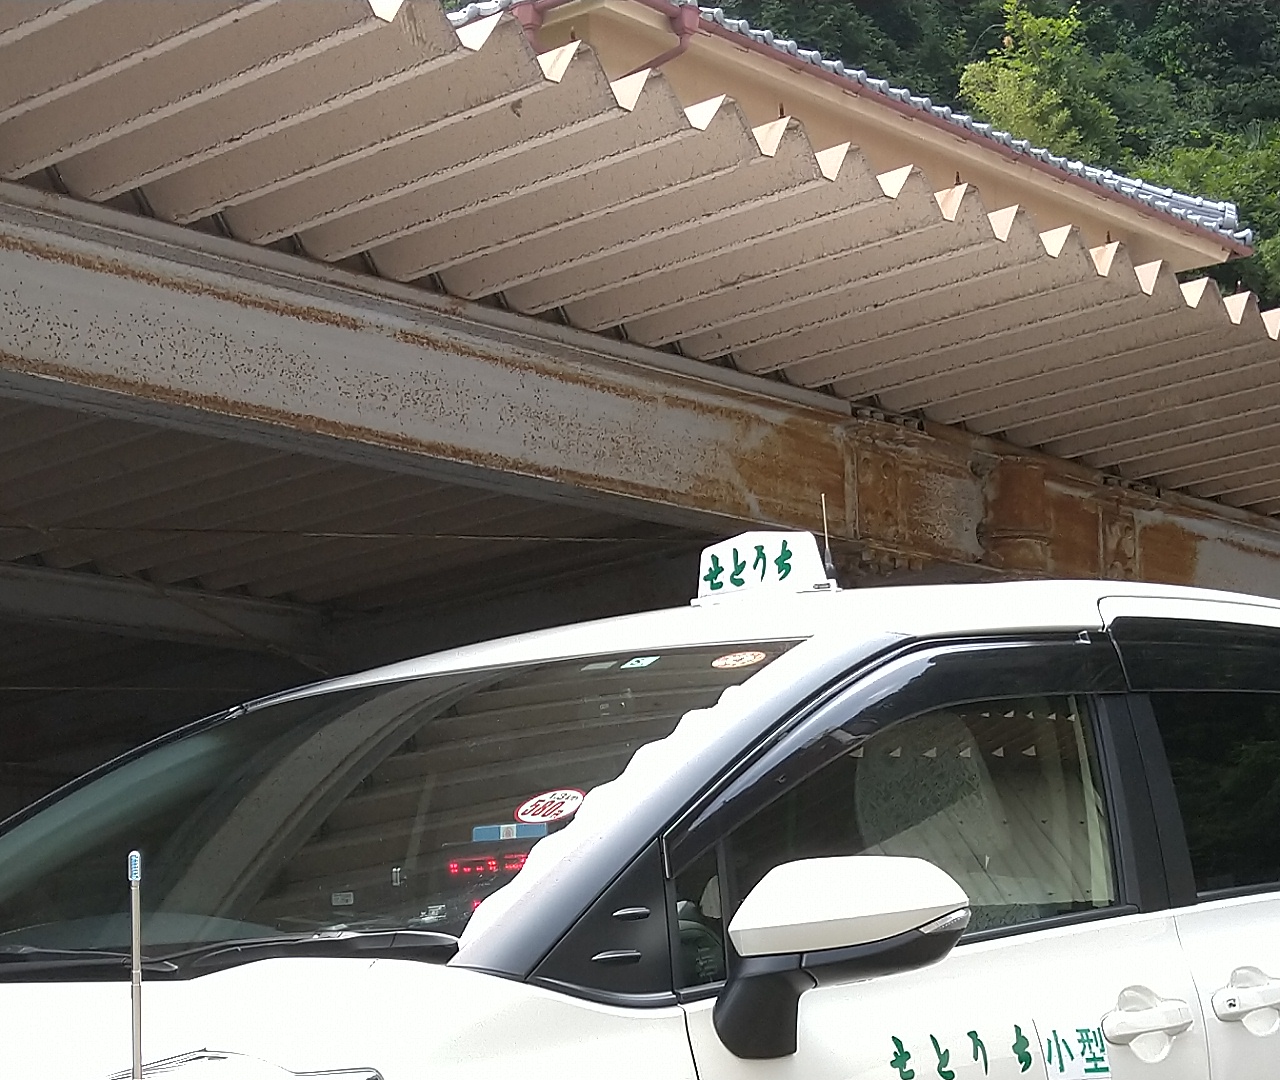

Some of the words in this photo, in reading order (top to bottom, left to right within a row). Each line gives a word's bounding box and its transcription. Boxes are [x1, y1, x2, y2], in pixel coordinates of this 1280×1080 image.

[703, 539, 793, 591] せとうち
[889, 1024, 1032, 1080] せとうち
[1046, 1027, 1110, 1074] 小型
